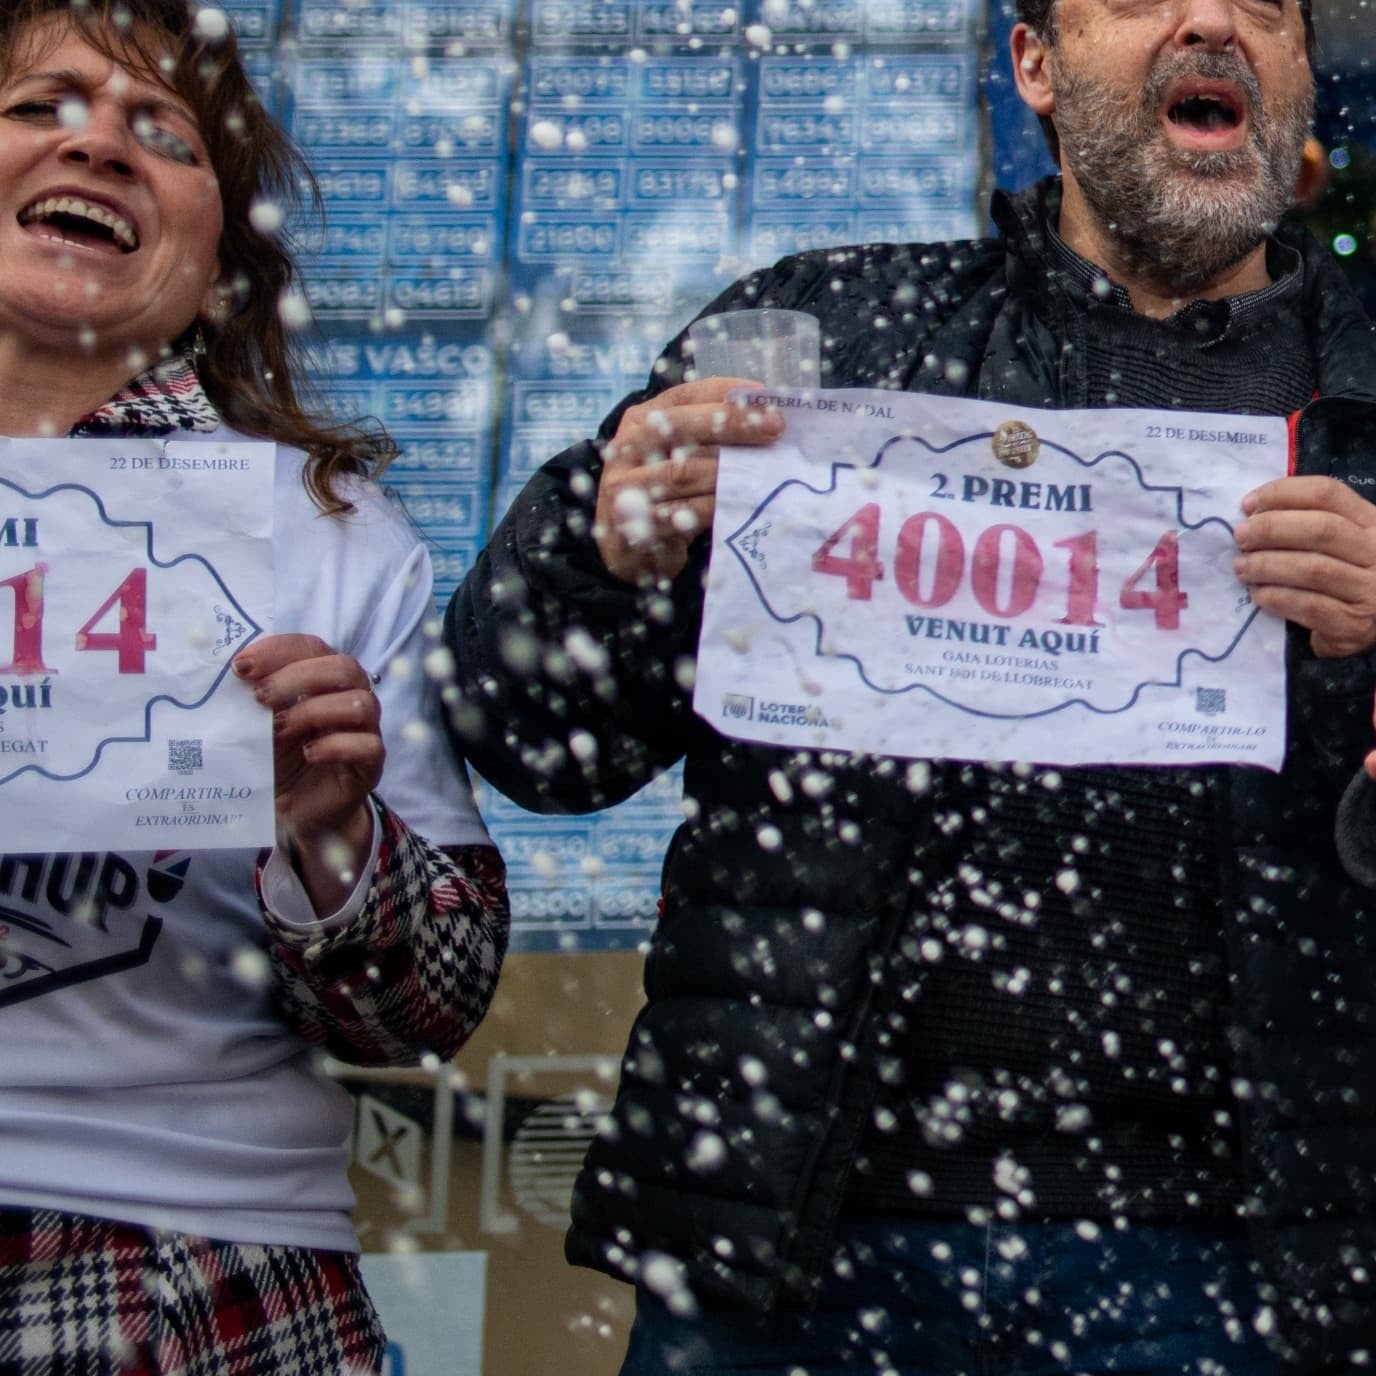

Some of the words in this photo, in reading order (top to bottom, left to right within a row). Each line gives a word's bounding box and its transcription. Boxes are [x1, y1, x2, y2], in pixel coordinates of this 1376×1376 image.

[365, 344, 492, 374] VASCO
[816, 398, 838, 413] DE
[1145, 426, 1161, 440] 22
[1164, 427, 1186, 441] DE
[1188, 428, 1269, 446] DESEMBRE
[109, 457, 128, 470] 22
[131, 457, 154, 470] DE
[158, 456, 250, 471] DESEMBRE
[962, 474, 1093, 512] PREMI
[811, 502, 1189, 630] 40014
[904, 614, 1012, 647] VENUT
[1017, 627, 1100, 656] AQUÍ
[904, 662, 946, 677] SANT
[942, 650, 981, 665] GAIA
[985, 653, 1060, 672] LOTERIAS
[125, 786, 252, 801] COMPARTIR-LO
